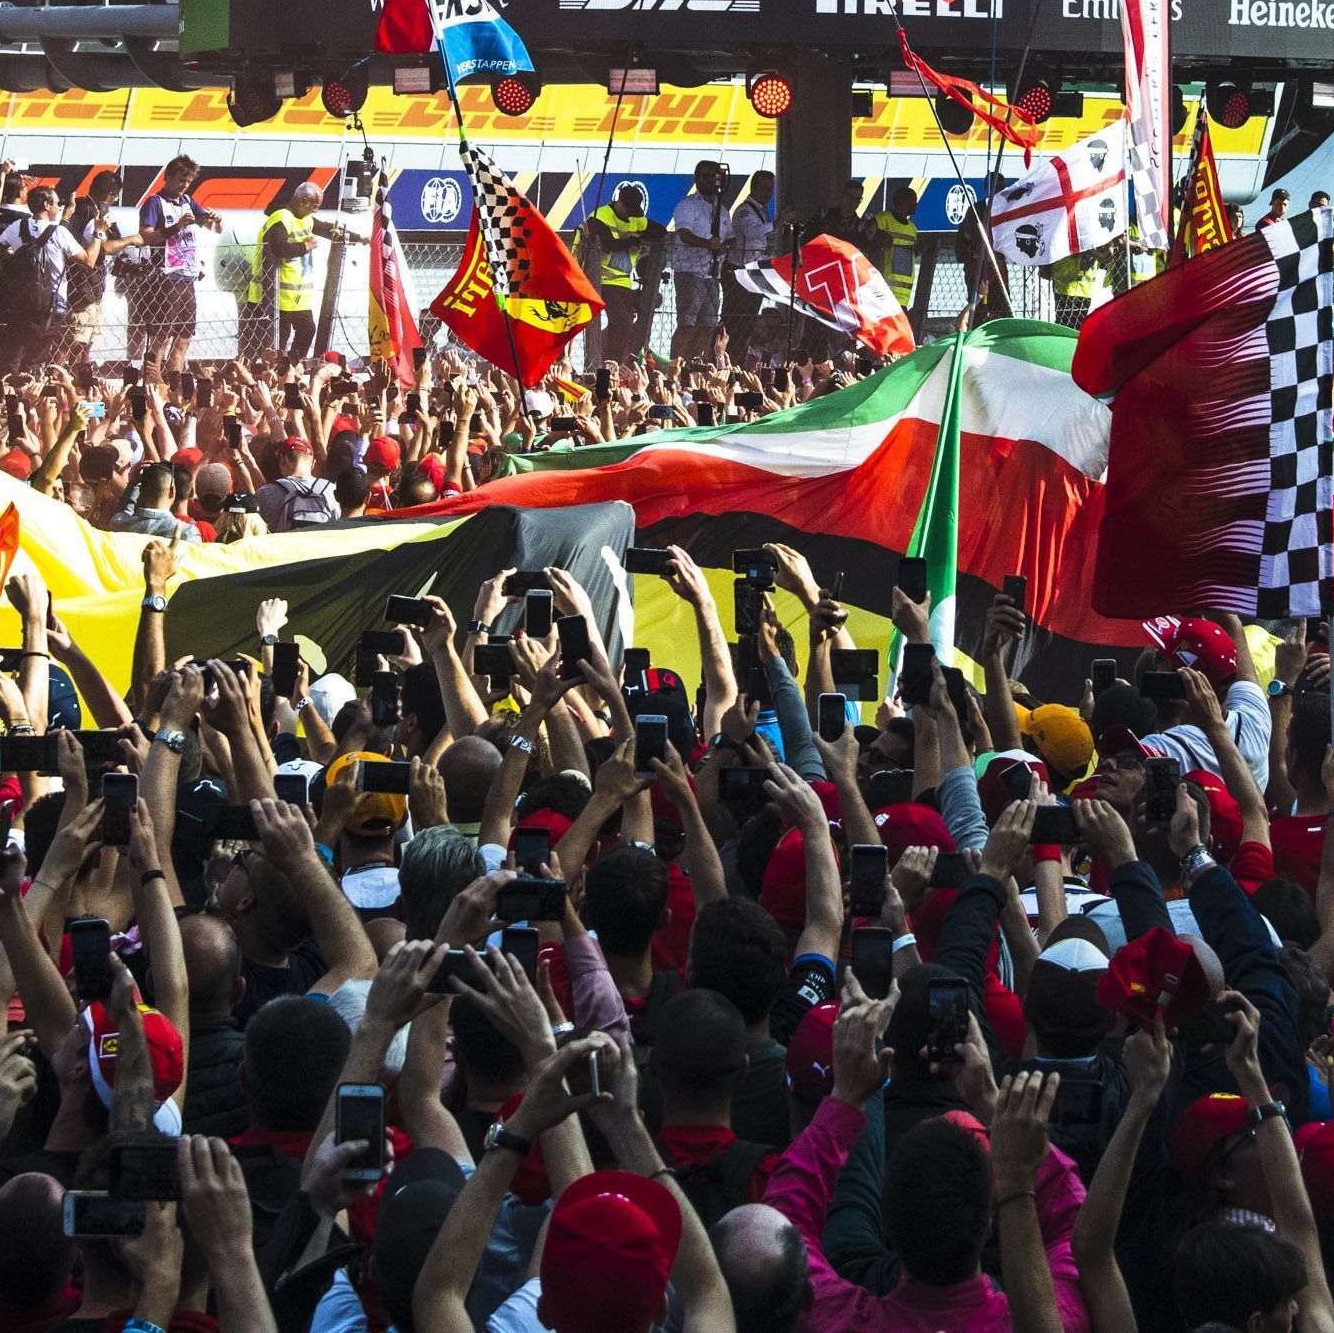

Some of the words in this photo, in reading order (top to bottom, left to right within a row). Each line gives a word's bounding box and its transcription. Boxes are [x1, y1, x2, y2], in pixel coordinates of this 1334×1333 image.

[456, 58, 517, 73] VERSTAPPEN
[594, 93, 719, 135] DHL
[422, 184, 461, 217] FIA
